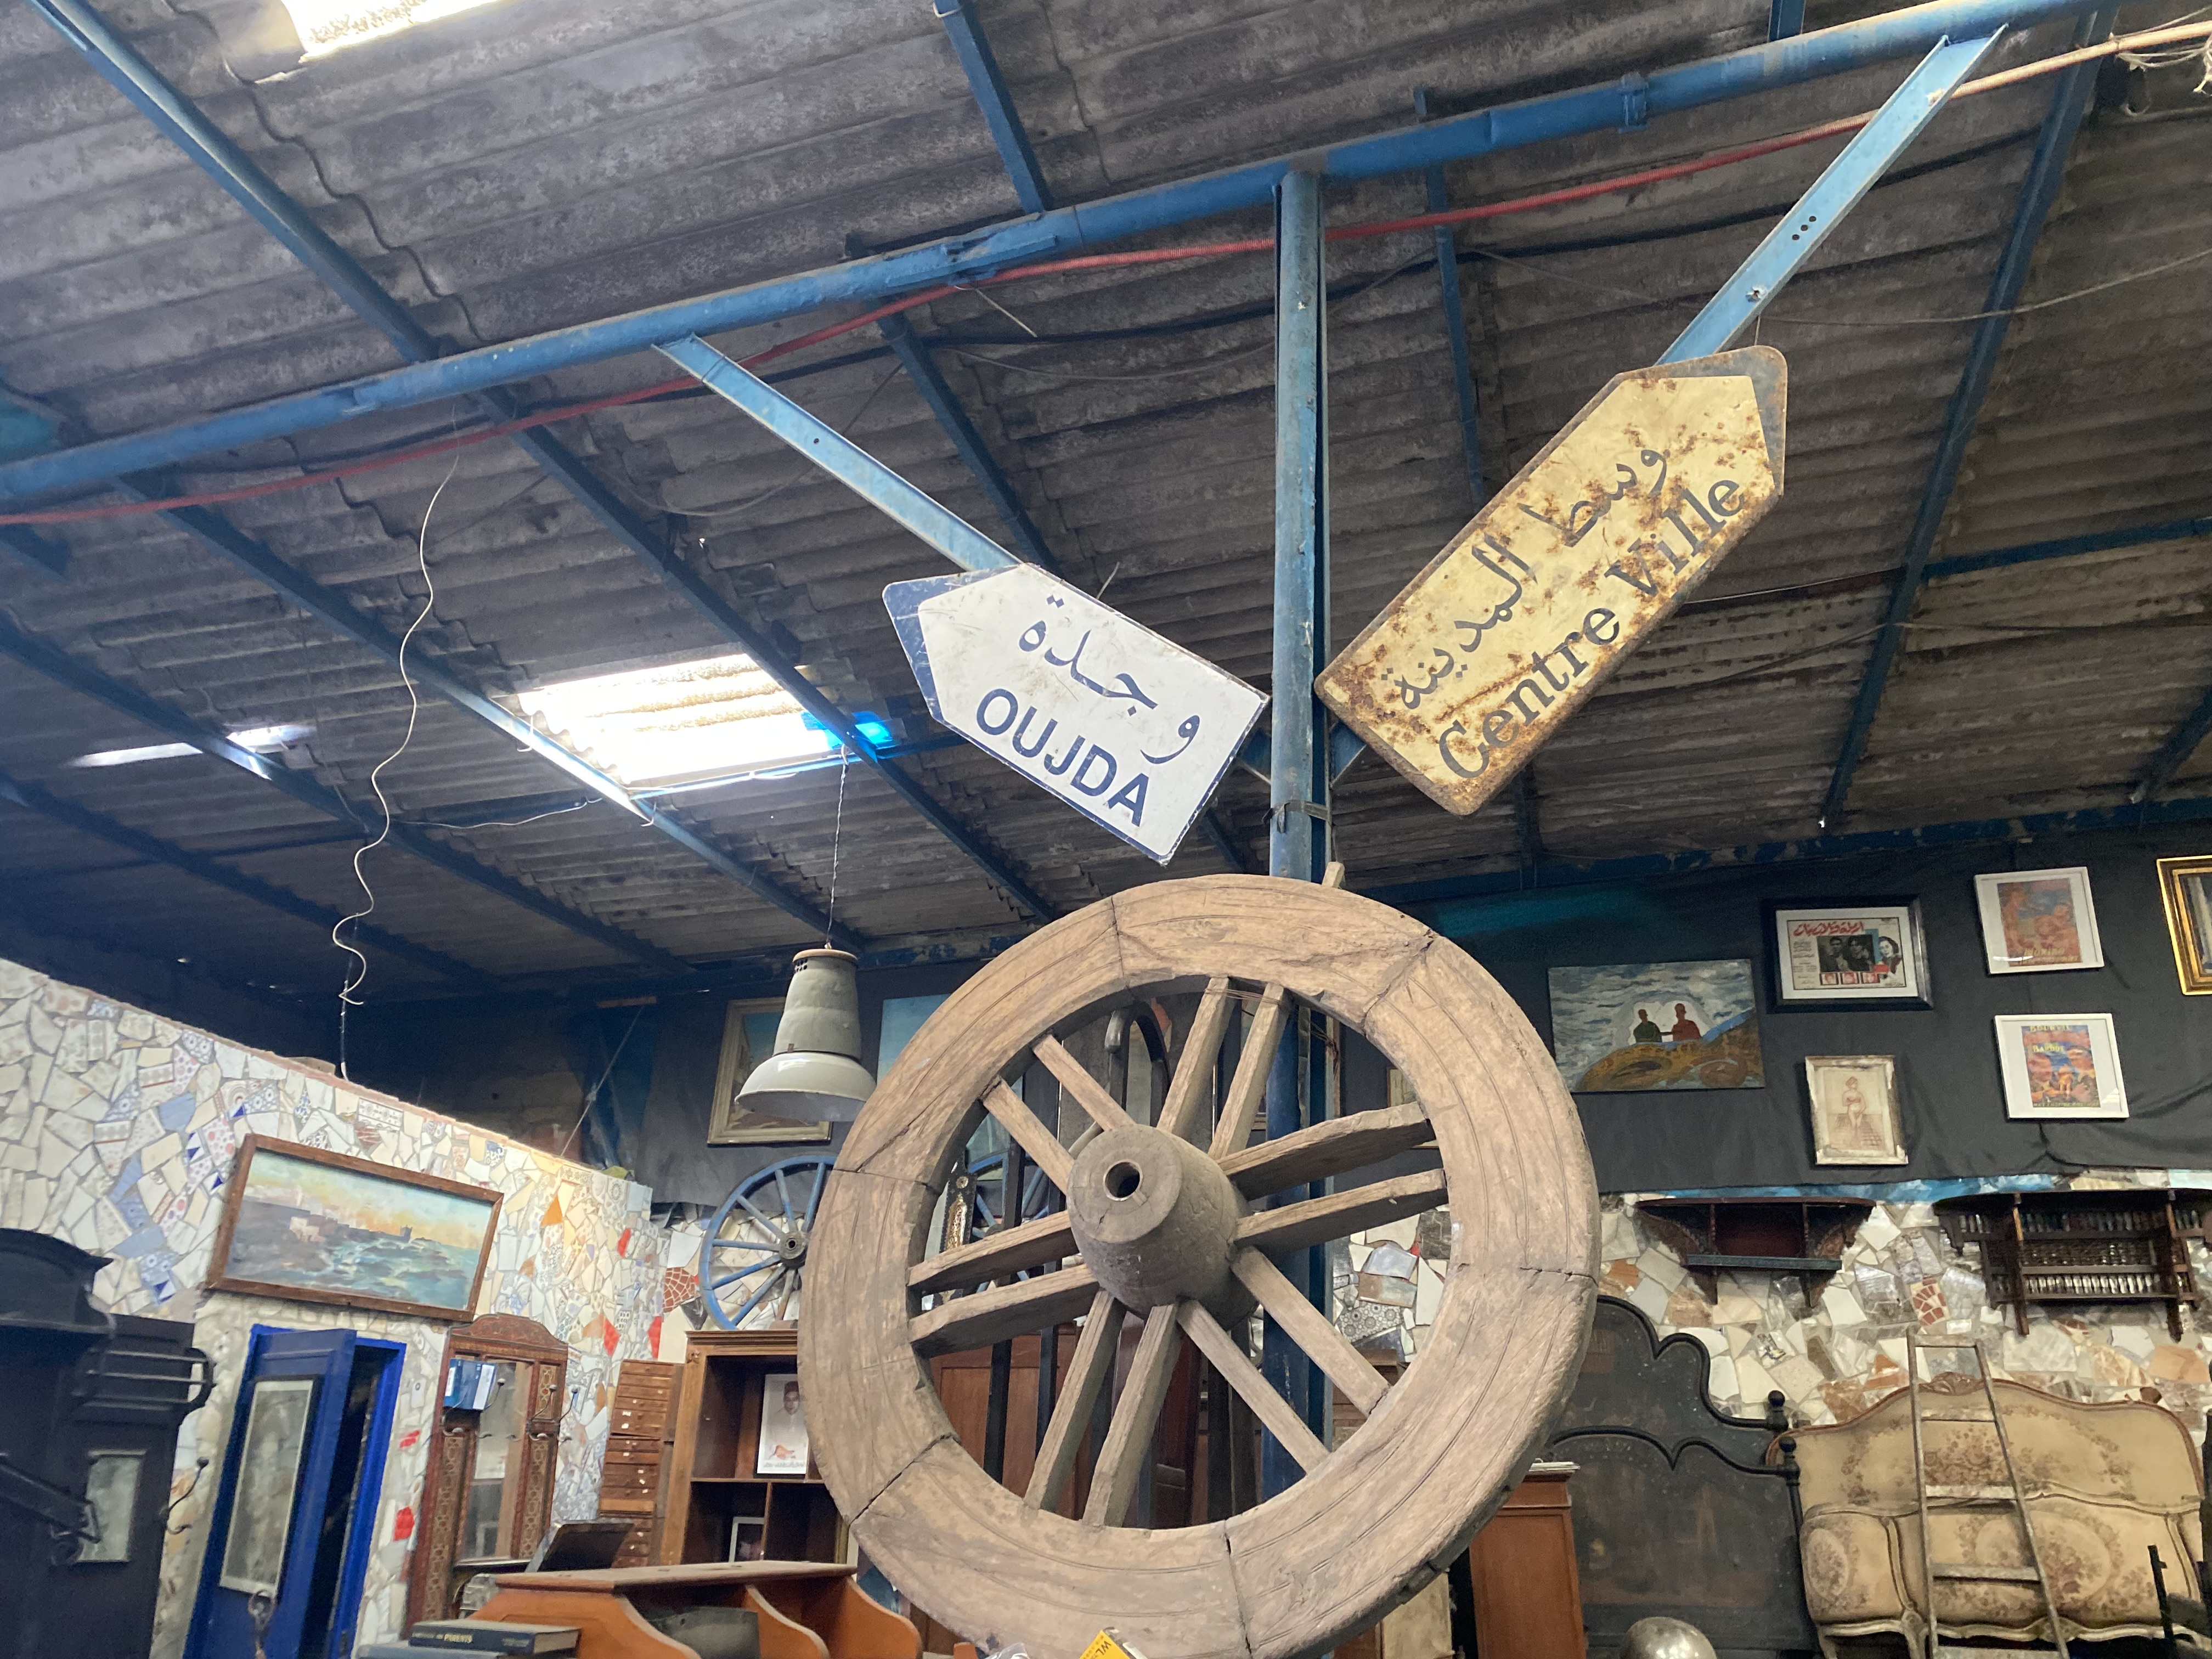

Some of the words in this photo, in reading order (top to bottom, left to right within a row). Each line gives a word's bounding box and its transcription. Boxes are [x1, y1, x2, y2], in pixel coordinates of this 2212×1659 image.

[1519, 449, 1668, 547] وسط
[1019, 594, 1200, 764] وجدة
[1381, 533, 1538, 710] المدينة
[1438, 608, 1620, 779] Centre
[1604, 479, 1744, 599] Ville
[976, 689, 1149, 827] OUJDA
